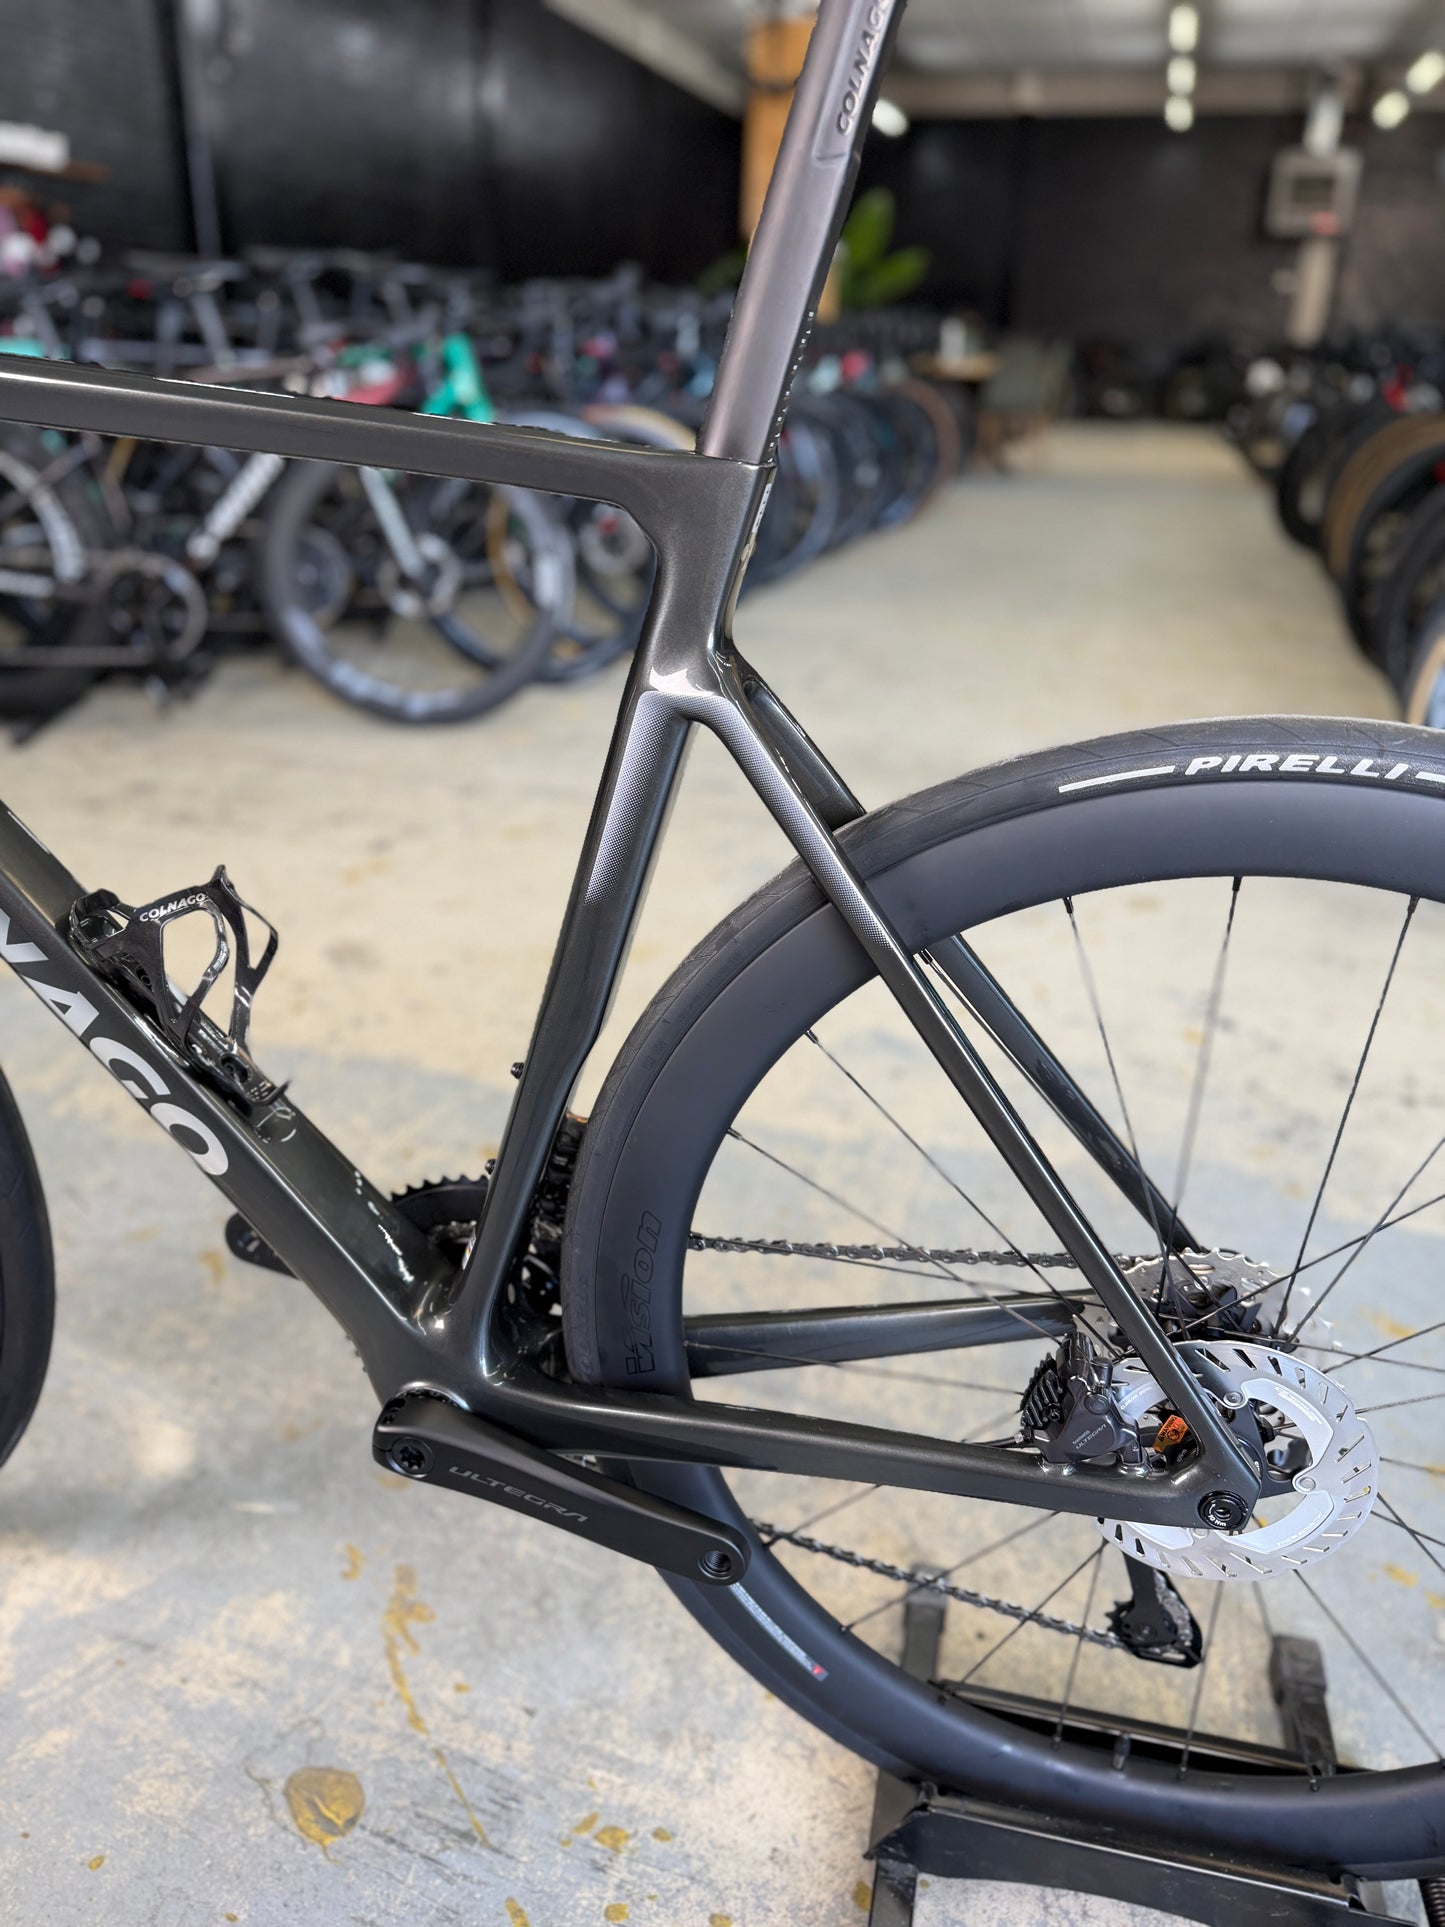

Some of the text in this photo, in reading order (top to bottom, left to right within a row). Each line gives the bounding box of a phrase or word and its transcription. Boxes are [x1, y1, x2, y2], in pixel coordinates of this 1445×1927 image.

[1184, 753, 1410, 780] PIRELLI
[139, 892, 207, 922] COLNAGO
[449, 1465, 589, 1523] ULTEGRA
